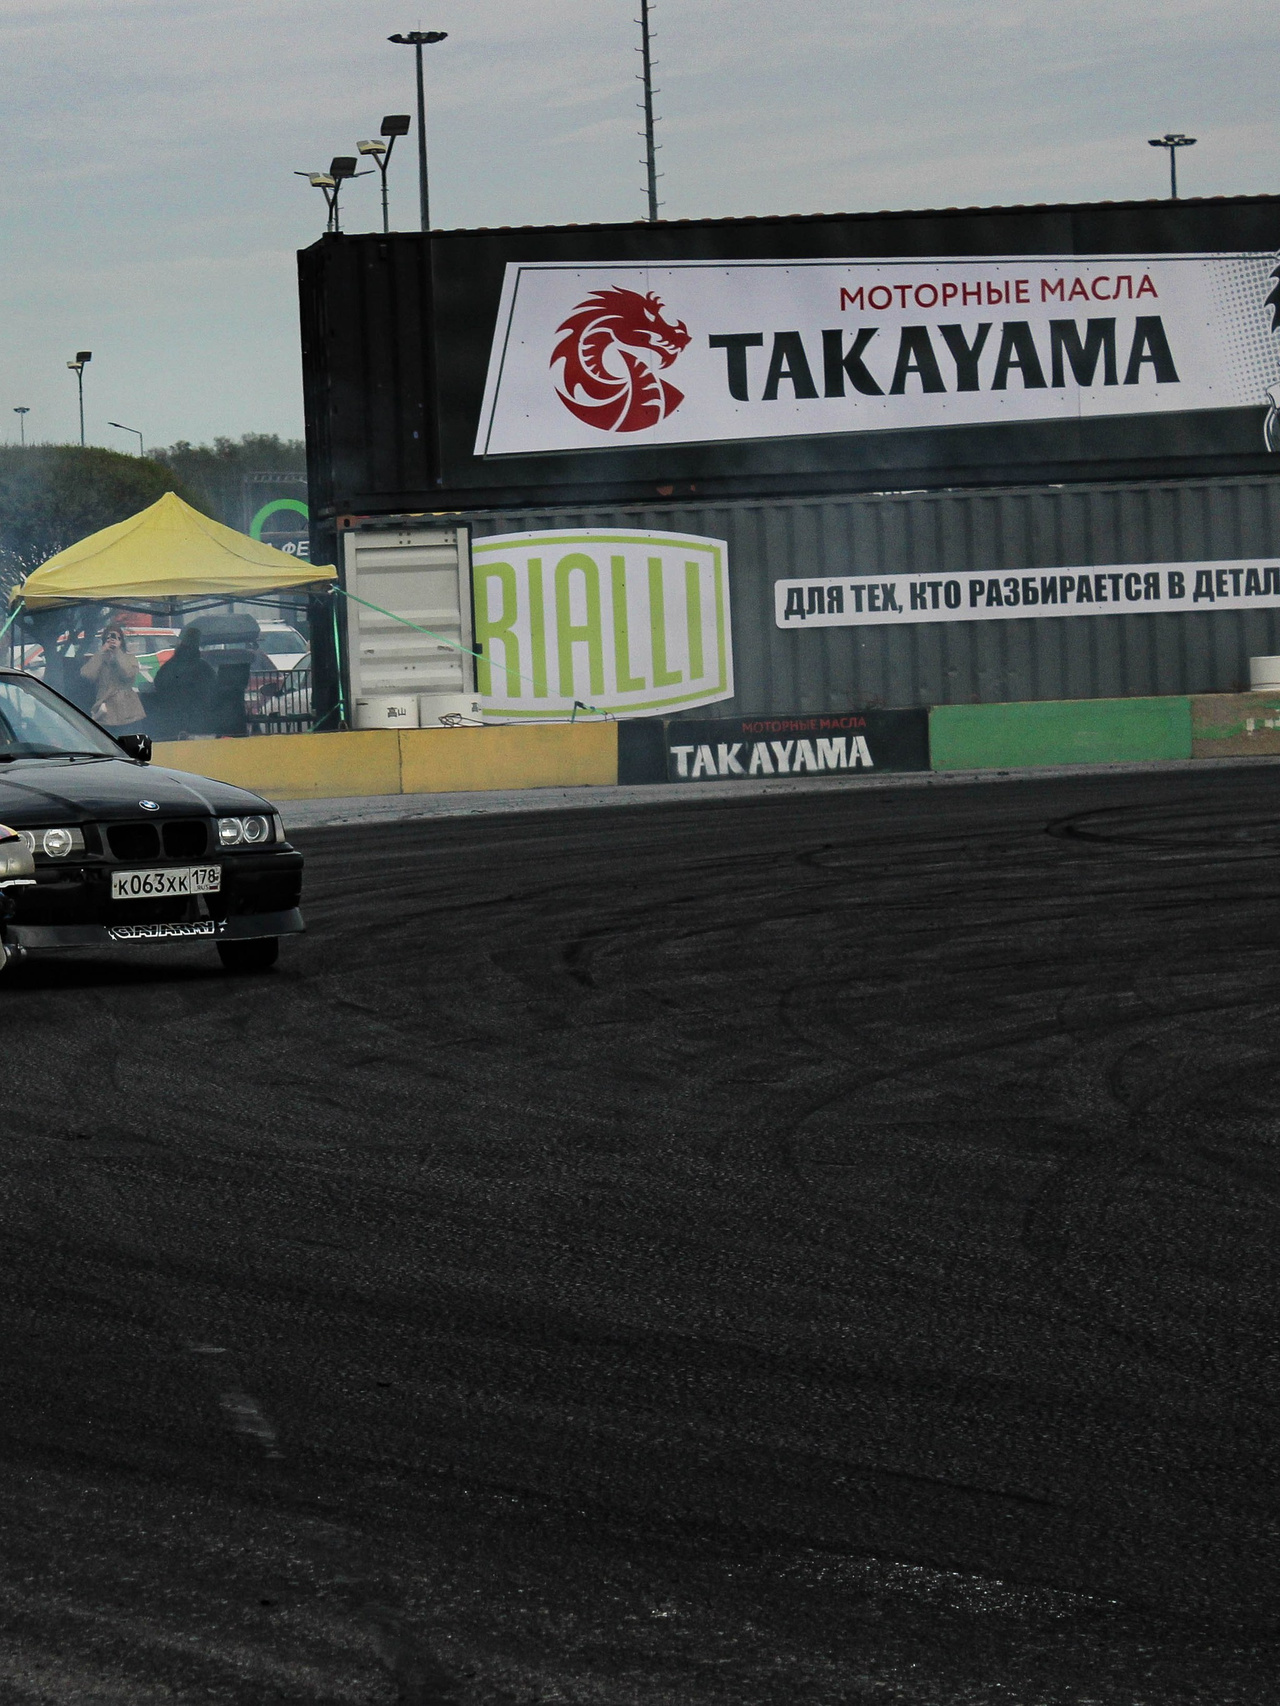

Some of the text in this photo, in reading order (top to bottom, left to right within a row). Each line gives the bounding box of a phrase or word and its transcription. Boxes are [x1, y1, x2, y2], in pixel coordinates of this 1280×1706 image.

[839, 274, 1159, 311] МОТОРНЫЕ МАСЛА
[708, 314, 1180, 402] TAKAYAMA
[784, 585, 844, 621] ДЛЯ
[850, 582, 904, 614] ТЕХ,
[910, 579, 962, 610] КТО
[969, 571, 1161, 608] РАЗБИРАЕТСЯ
[1167, 571, 1186, 599] В
[473, 552, 705, 698] RIALLI
[742, 716, 867, 733] МОТОРНЫЕ МАСЛА
[670, 735, 874, 777] TAKAYAMA
[192, 869, 215, 884] 178
